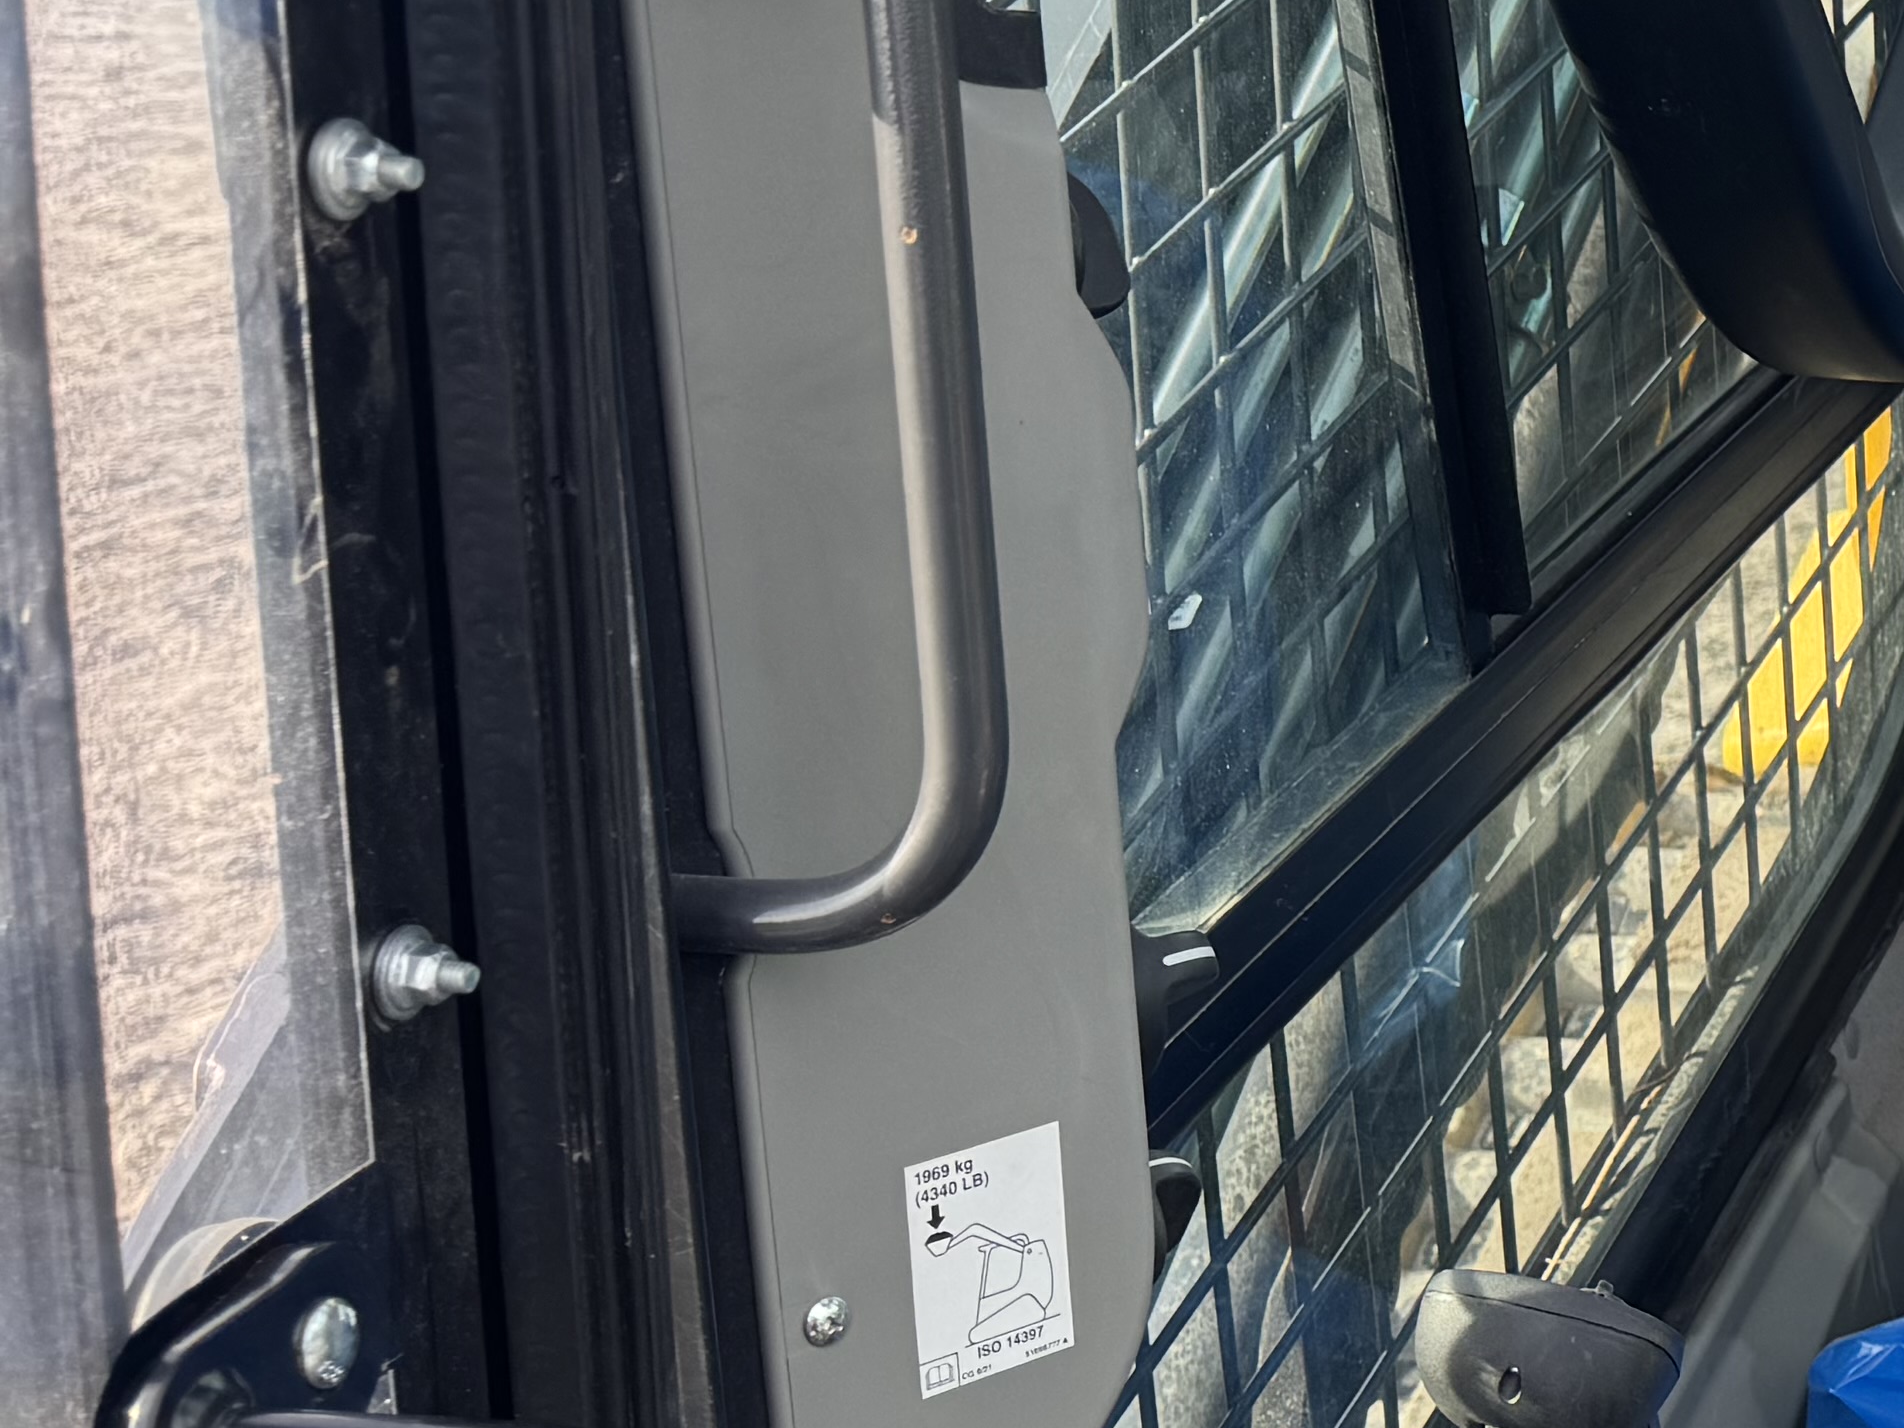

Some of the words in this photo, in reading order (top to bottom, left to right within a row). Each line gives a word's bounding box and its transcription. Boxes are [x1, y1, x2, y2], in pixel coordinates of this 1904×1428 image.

[914, 1164, 950, 1185] 1969
[955, 1159, 973, 1175] kg
[915, 1181, 958, 1209] (4340
[962, 1170, 989, 1191] LB)
[977, 1340, 1002, 1359] ISO
[1007, 1325, 1044, 1348] 14397
